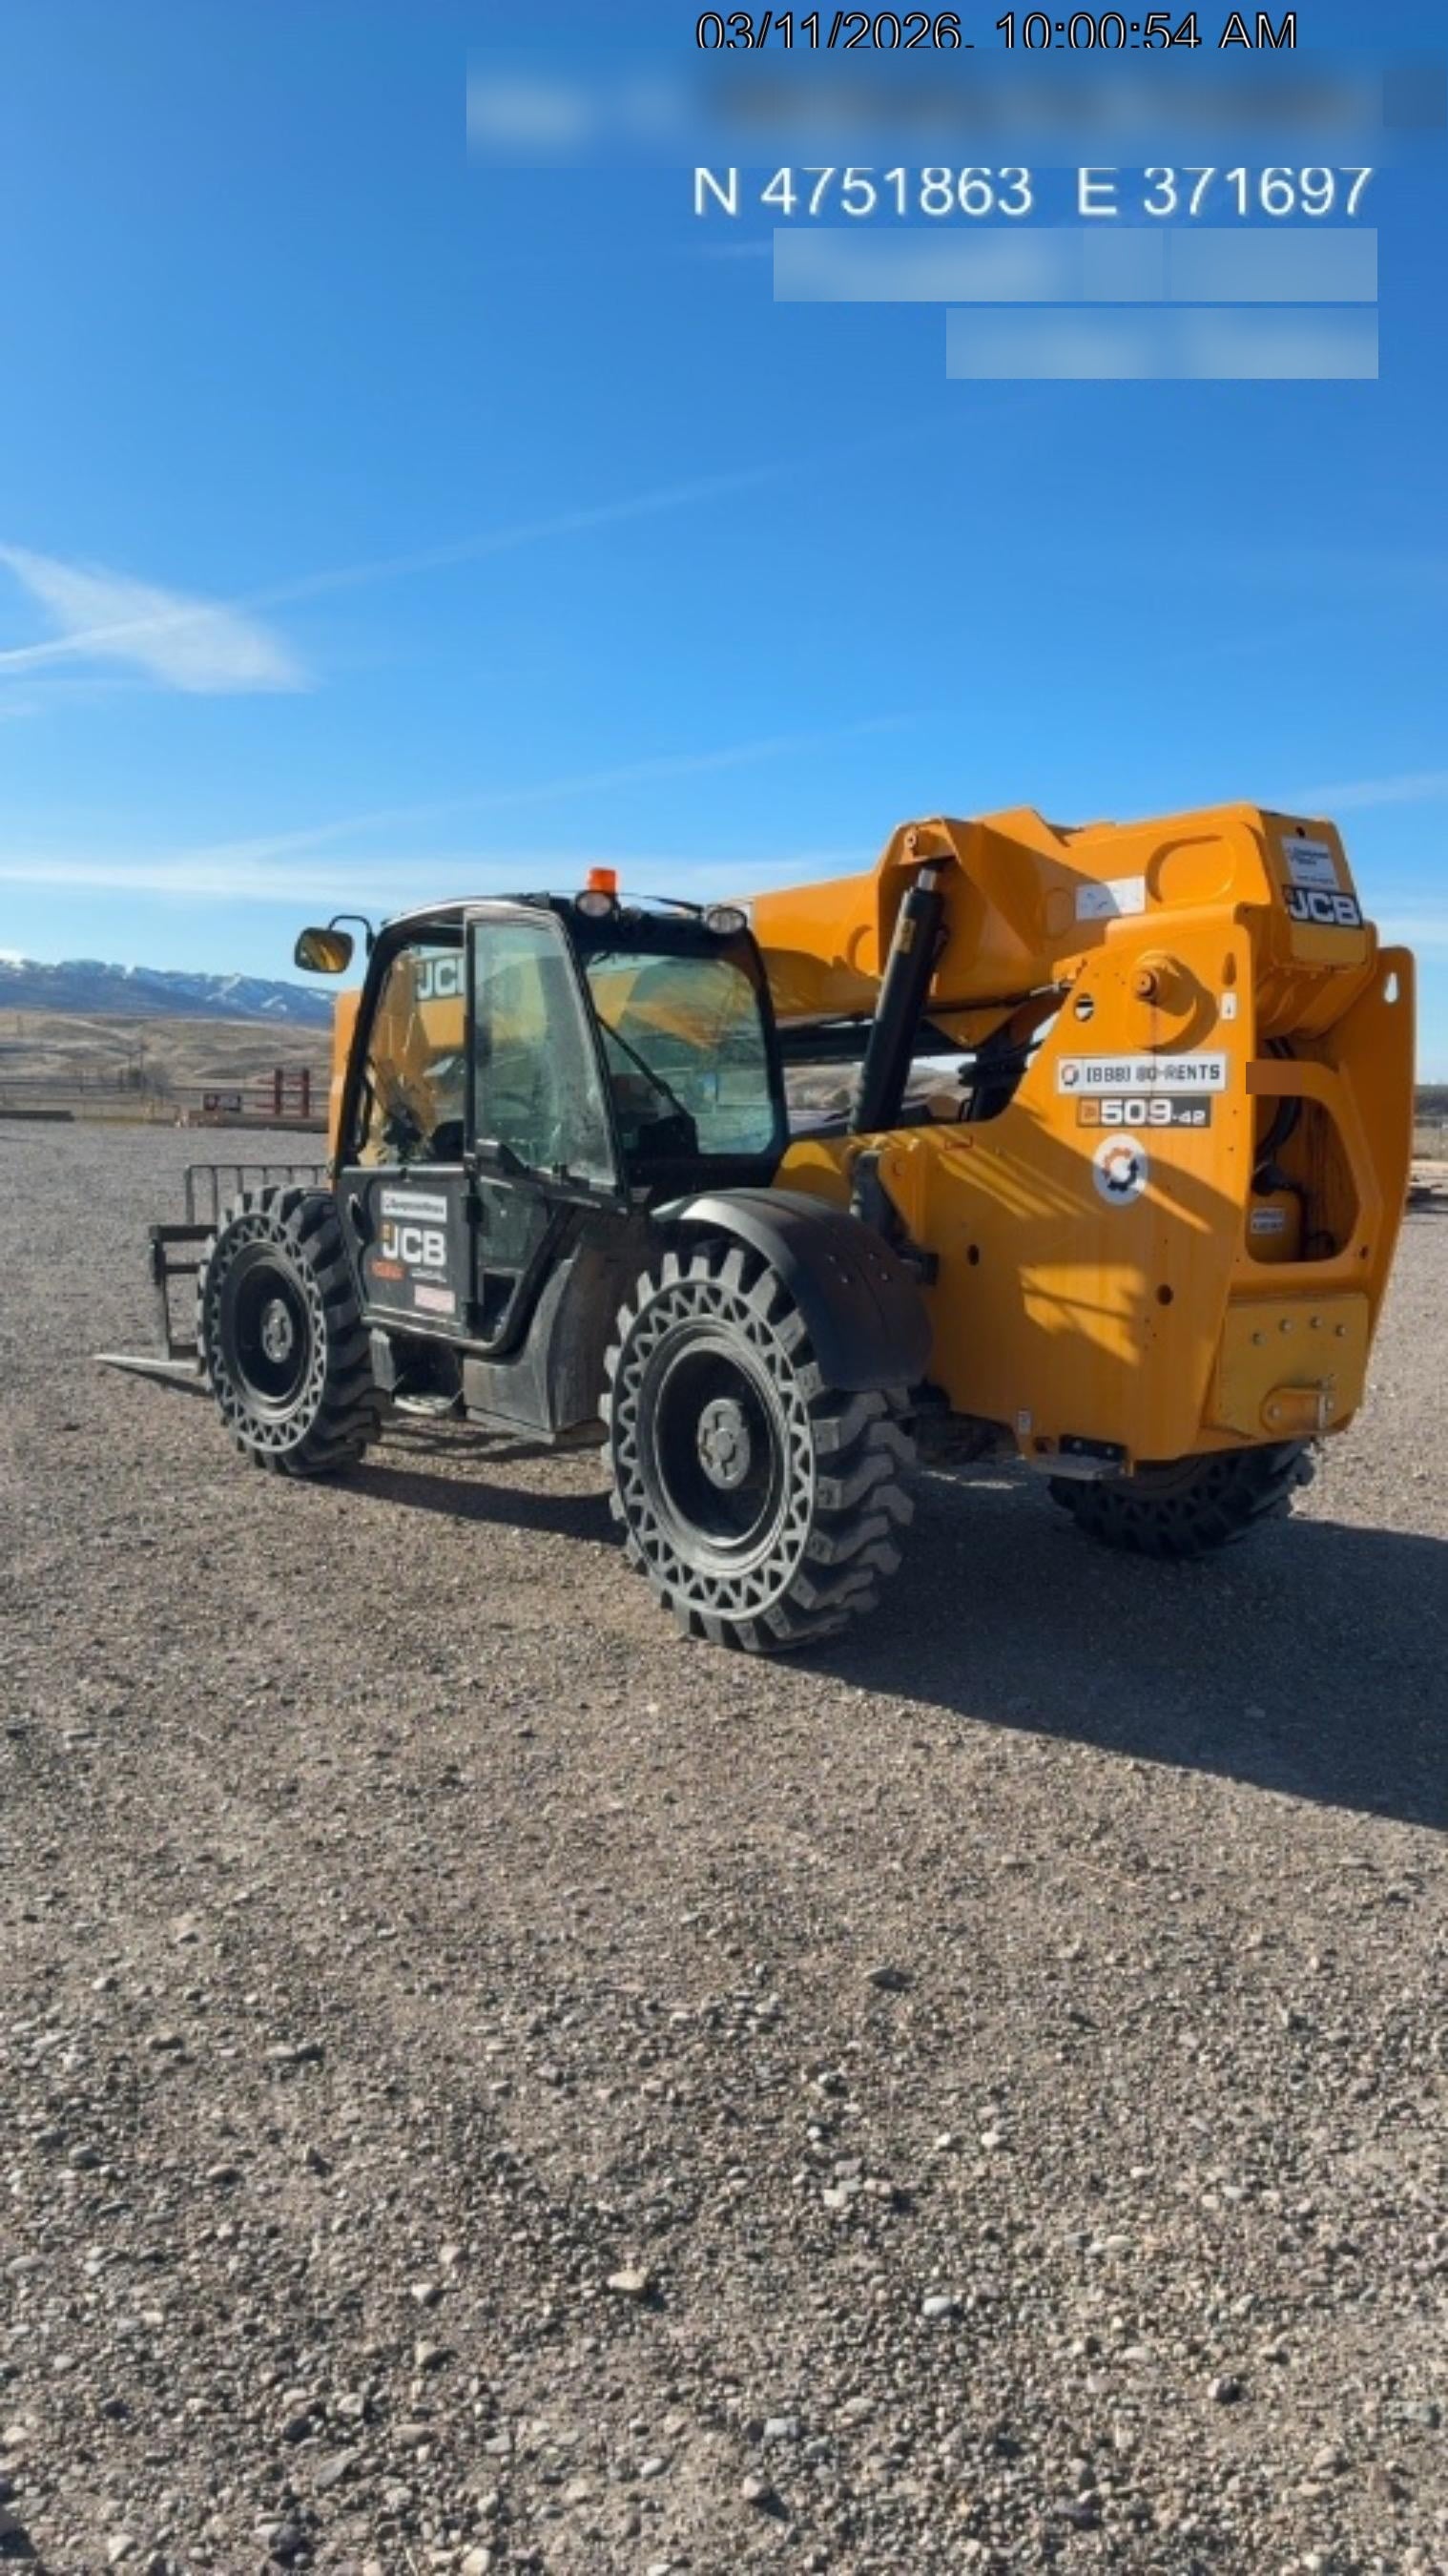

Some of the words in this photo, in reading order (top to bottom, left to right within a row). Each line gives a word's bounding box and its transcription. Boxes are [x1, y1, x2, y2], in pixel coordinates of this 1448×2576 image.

[1289, 889, 1360, 925] JCB
[1136, 1064, 1220, 1082] 80-RENTS
[382, 1224, 446, 1266] JCB
